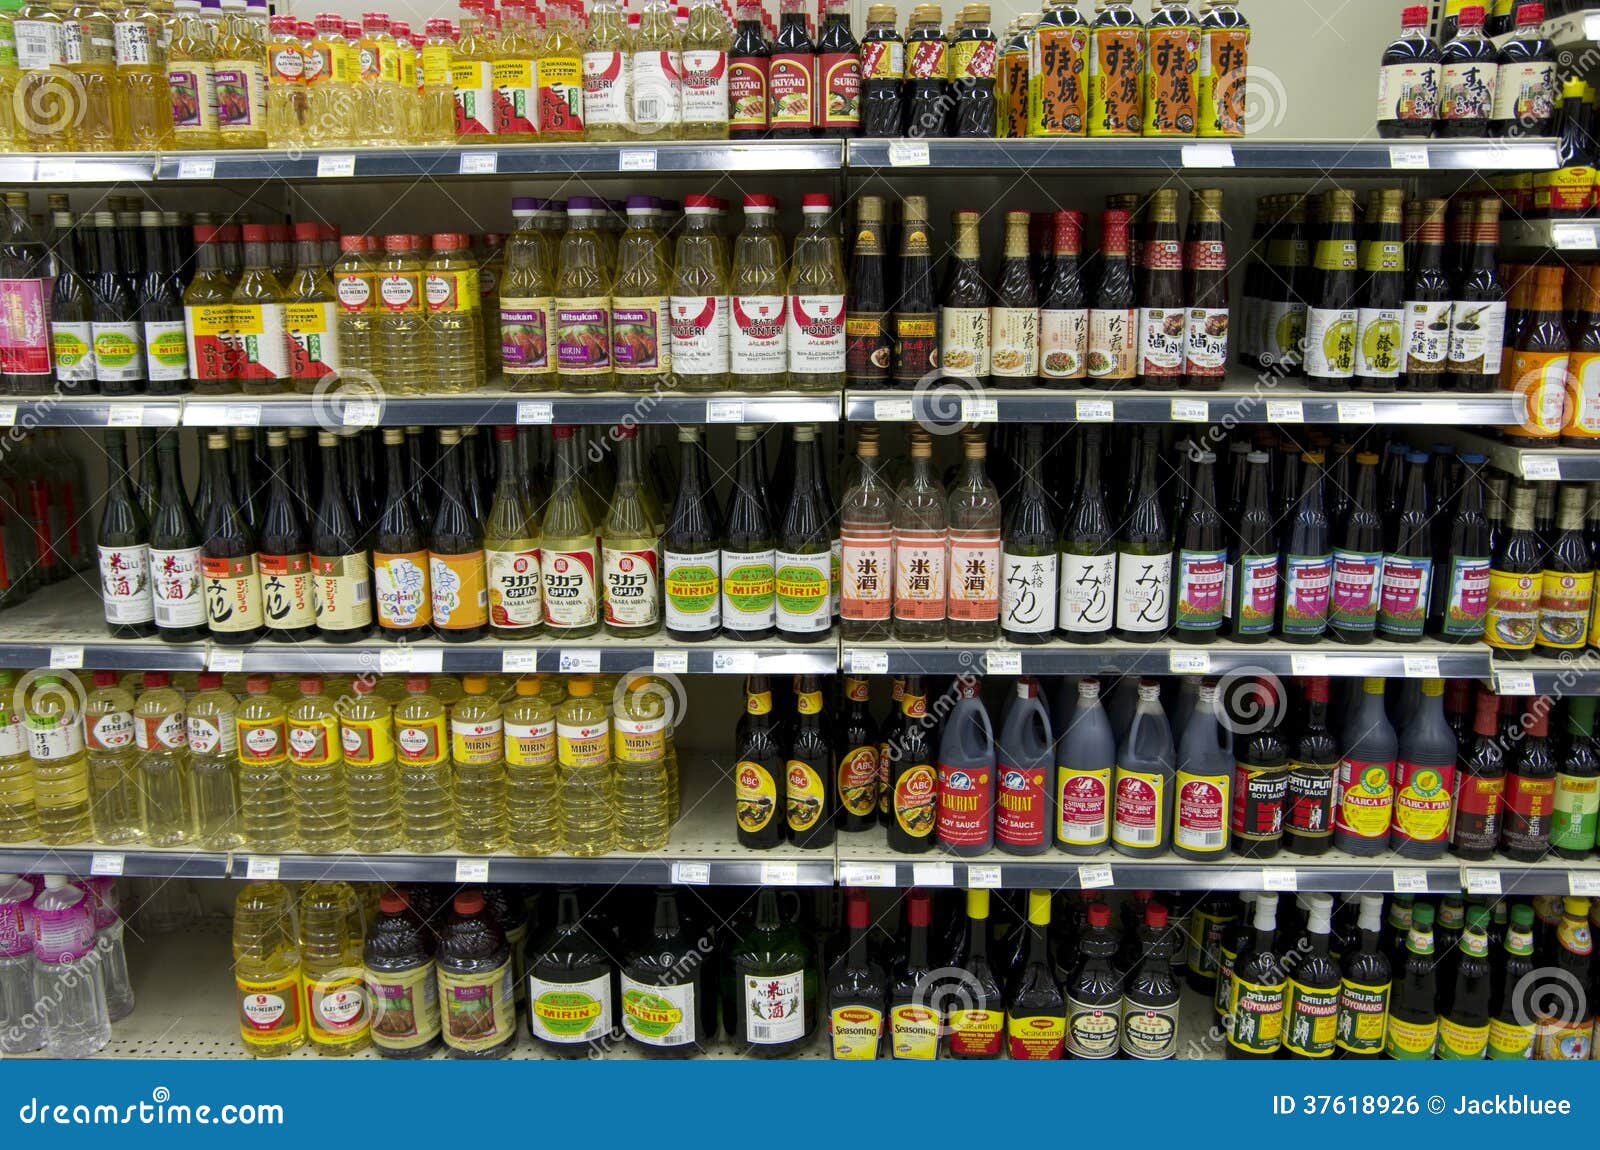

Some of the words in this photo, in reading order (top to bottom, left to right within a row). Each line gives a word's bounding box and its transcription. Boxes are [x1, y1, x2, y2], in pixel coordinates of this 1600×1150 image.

[730, 81, 760, 89] KIYAKI
[771, 78, 804, 86] UKIYAKI
[834, 78, 859, 86] SUKIY
[560, 312, 598, 321] Mitsukan
[613, 313, 643, 321] itsukan
[742, 327, 784, 336] HONTERI
[801, 326, 843, 336] HONTERI
[608, 573, 647, 586] タカラ
[856, 558, 878, 591] 米酒
[908, 558, 930, 591] 米酒
[964, 558, 986, 591] 米酒
[501, 574, 539, 586] タカラ
[544, 574, 583, 587] タカラ
[507, 588, 536, 598] みりん
[548, 588, 579, 598] みりん
[612, 587, 643, 597] みりん
[672, 586, 714, 596] MIRIN
[732, 586, 773, 596] MIRIN
[779, 586, 821, 596] MIRIN
[1007, 564, 1044, 624] みりん
[1076, 564, 1111, 624] みりん
[1136, 564, 1169, 623] みりん
[207, 578, 233, 623] みりん
[265, 575, 291, 620] みりん
[465, 741, 491, 749] MIRIN
[519, 743, 546, 752] MIRIN
[571, 744, 598, 753] MIRIN
[625, 739, 650, 748] MIRIN
[857, 761, 873, 770] ABC
[741, 777, 757, 786] ABC
[790, 775, 806, 786] ABC
[912, 781, 928, 790] ABC
[1313, 779, 1331, 789] PUT
[1249, 783, 1274, 793] DATU
[1275, 782, 1287, 792] PU
[1305, 788, 1328, 796] SAUCE
[942, 792, 979, 812] LAURIAT
[1347, 796, 1377, 806] MARCA
[1400, 796, 1430, 809] MARCA
[941, 818, 954, 826] SOY
[956, 820, 980, 828] SAUCE
[1010, 820, 1035, 828] SAUCE
[1301, 995, 1322, 1004] DATU
[1344, 989, 1364, 1001] DATU
[246, 1004, 282, 1012] AJI-MIRIN
[1341, 996, 1383, 1011] TOYOMANSI
[543, 1009, 590, 1018] MIRIN
[627, 1005, 669, 1022] MIRIN
[836, 1026, 877, 1036] Seasoning
[895, 1024, 936, 1036] Seasoning
[1020, 1028, 1063, 1038] Seasoning
